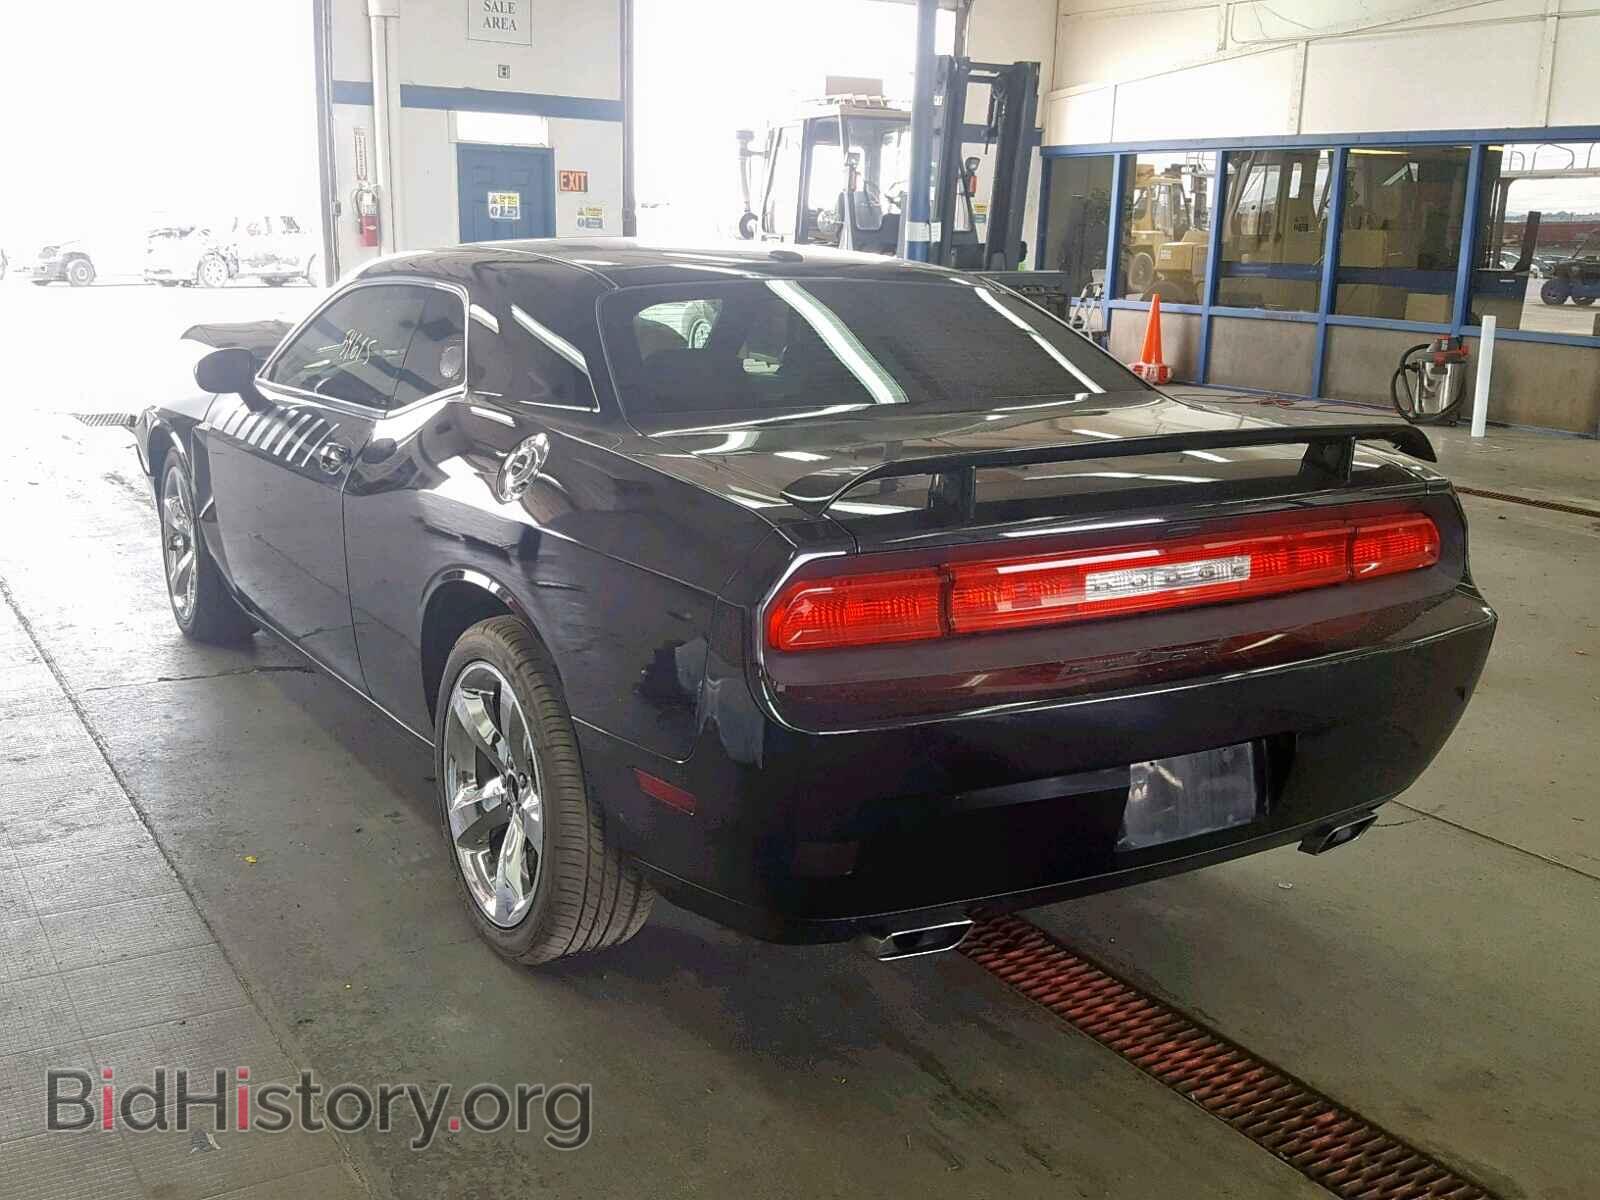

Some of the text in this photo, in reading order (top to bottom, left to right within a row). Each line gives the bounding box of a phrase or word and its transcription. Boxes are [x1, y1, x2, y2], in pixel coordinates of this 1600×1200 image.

[483, 0, 516, 14] SALE
[482, 16, 517, 31] AREA
[560, 171, 587, 191] EXIT
